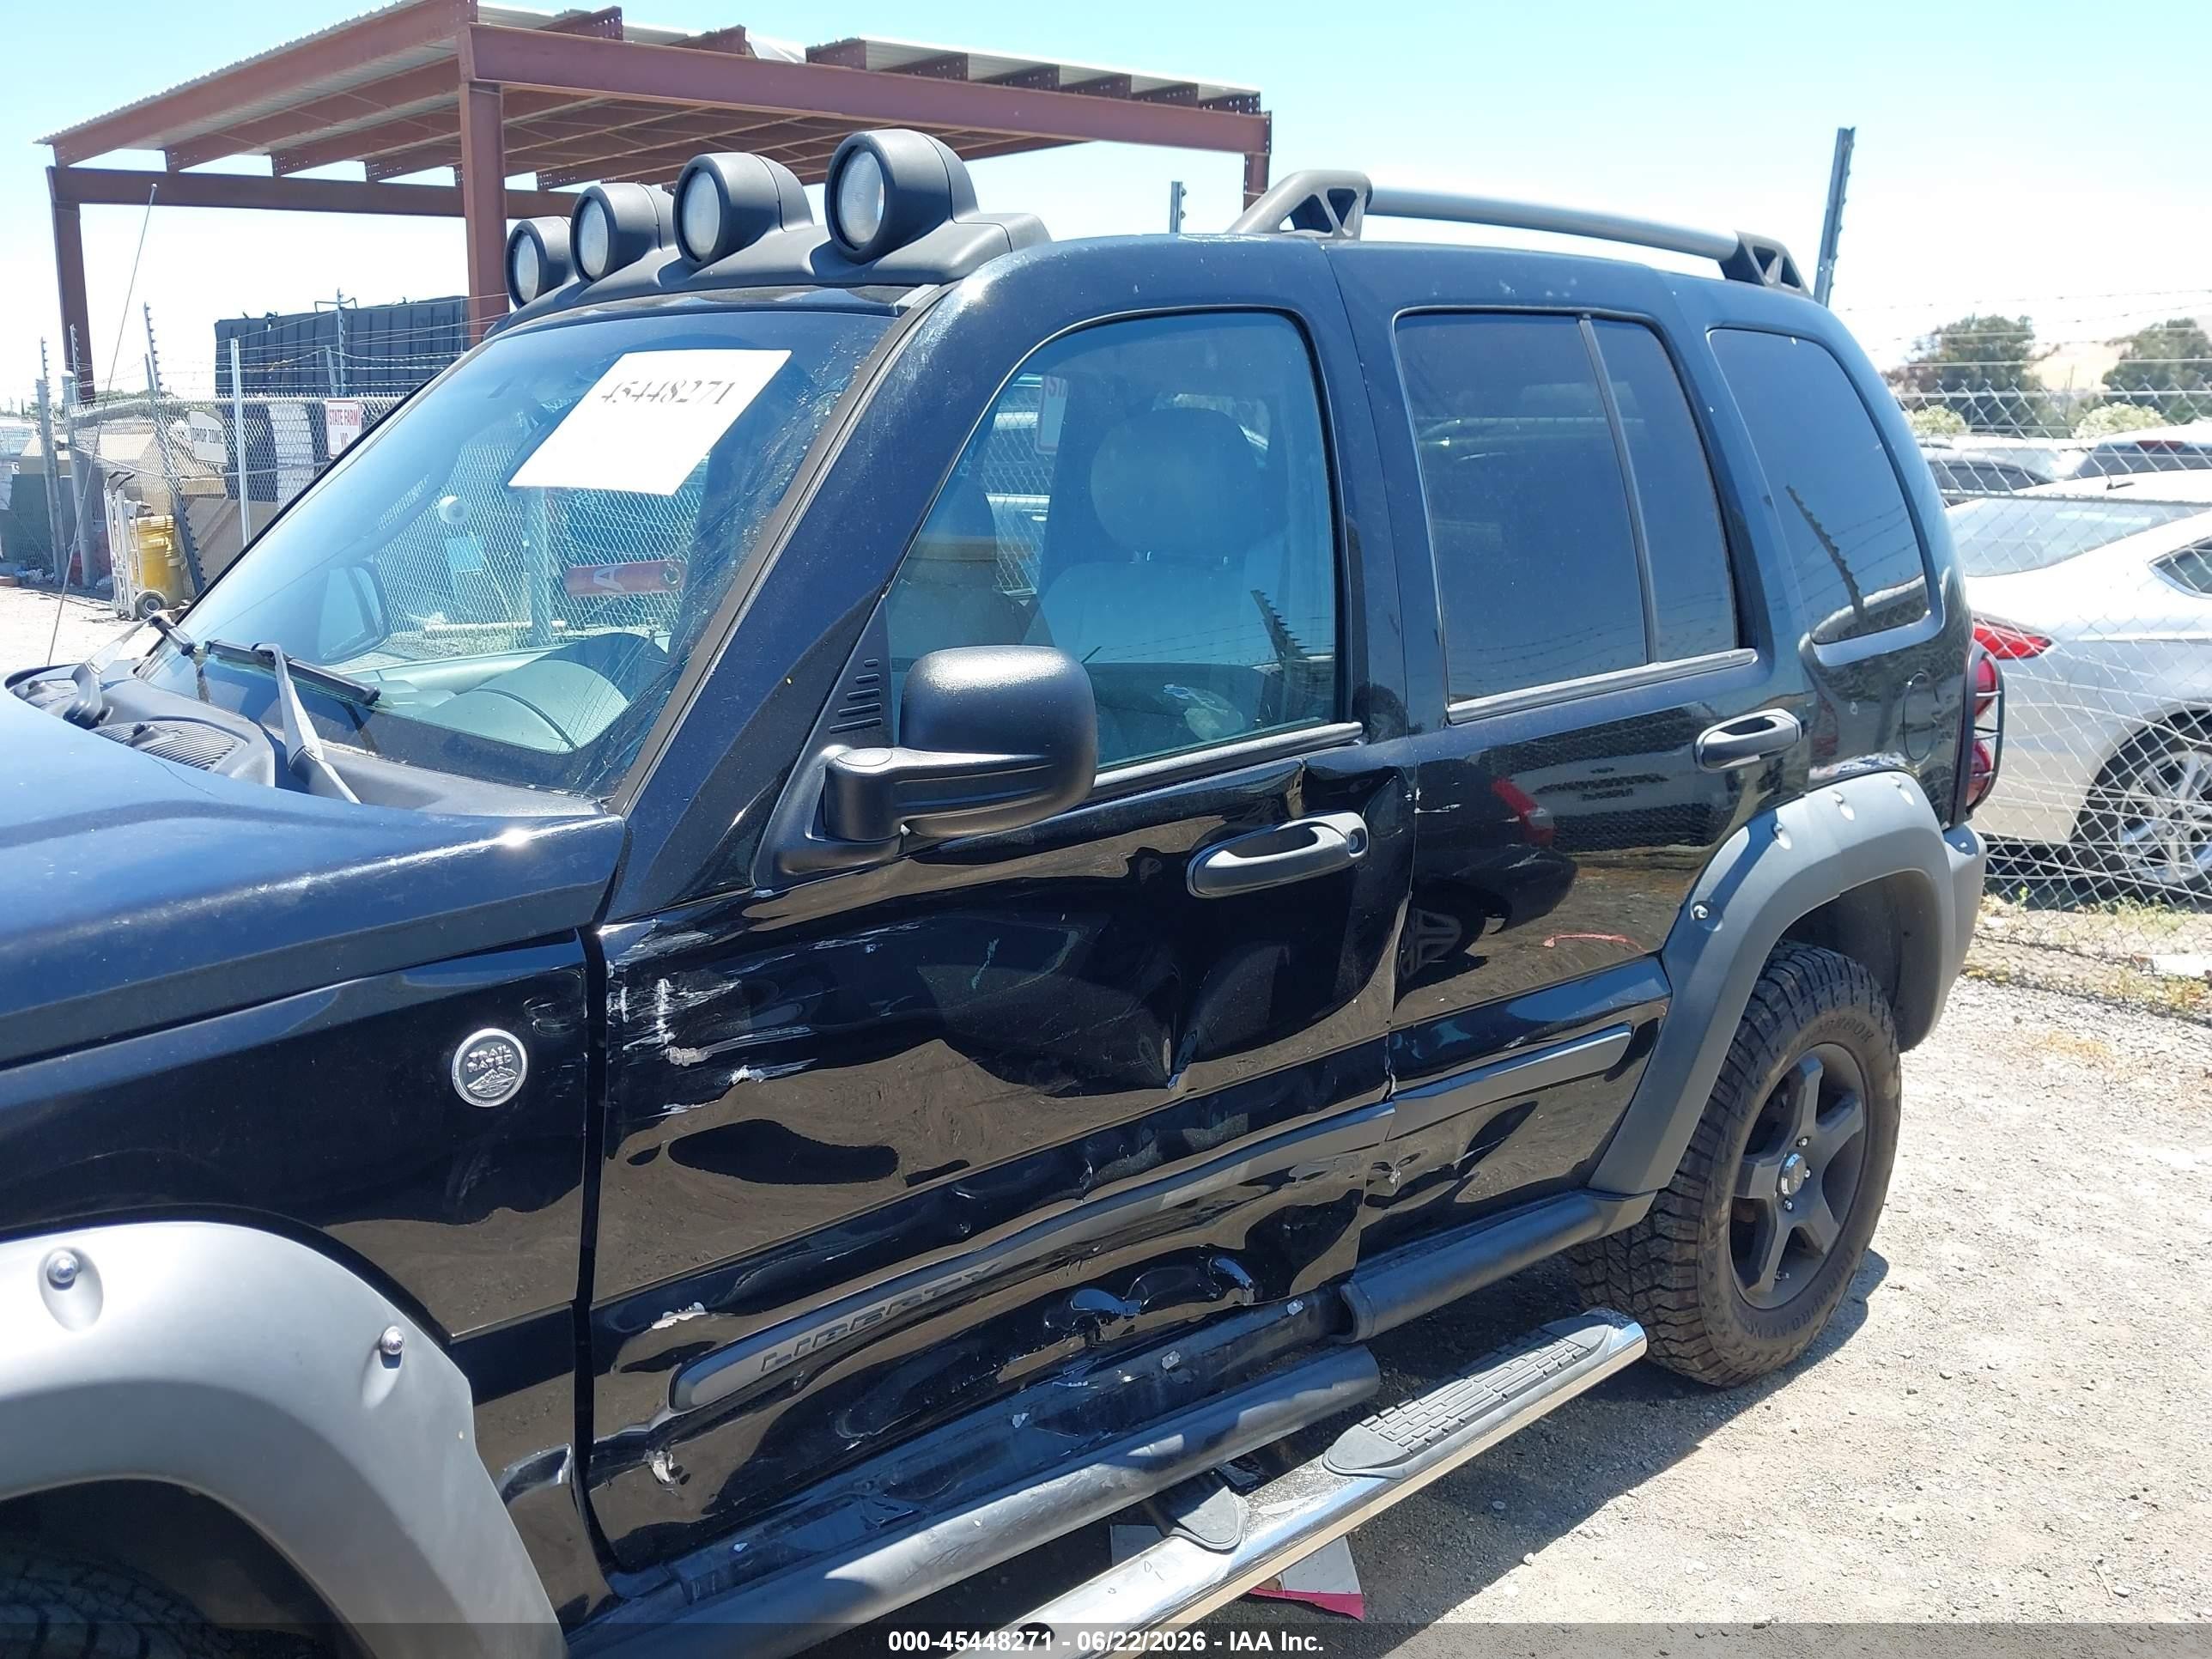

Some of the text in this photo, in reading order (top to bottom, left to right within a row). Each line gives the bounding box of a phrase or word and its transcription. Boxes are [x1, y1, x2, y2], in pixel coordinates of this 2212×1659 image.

[601, 380, 736, 404] 45448271
[329, 409, 359, 427] STATE FARM
[192, 428, 224, 445] DROP ZONE
[466, 1054, 514, 1073] RATED
[468, 1045, 511, 1064] TRAIL
[761, 1261, 1003, 1372] LIBERTY
